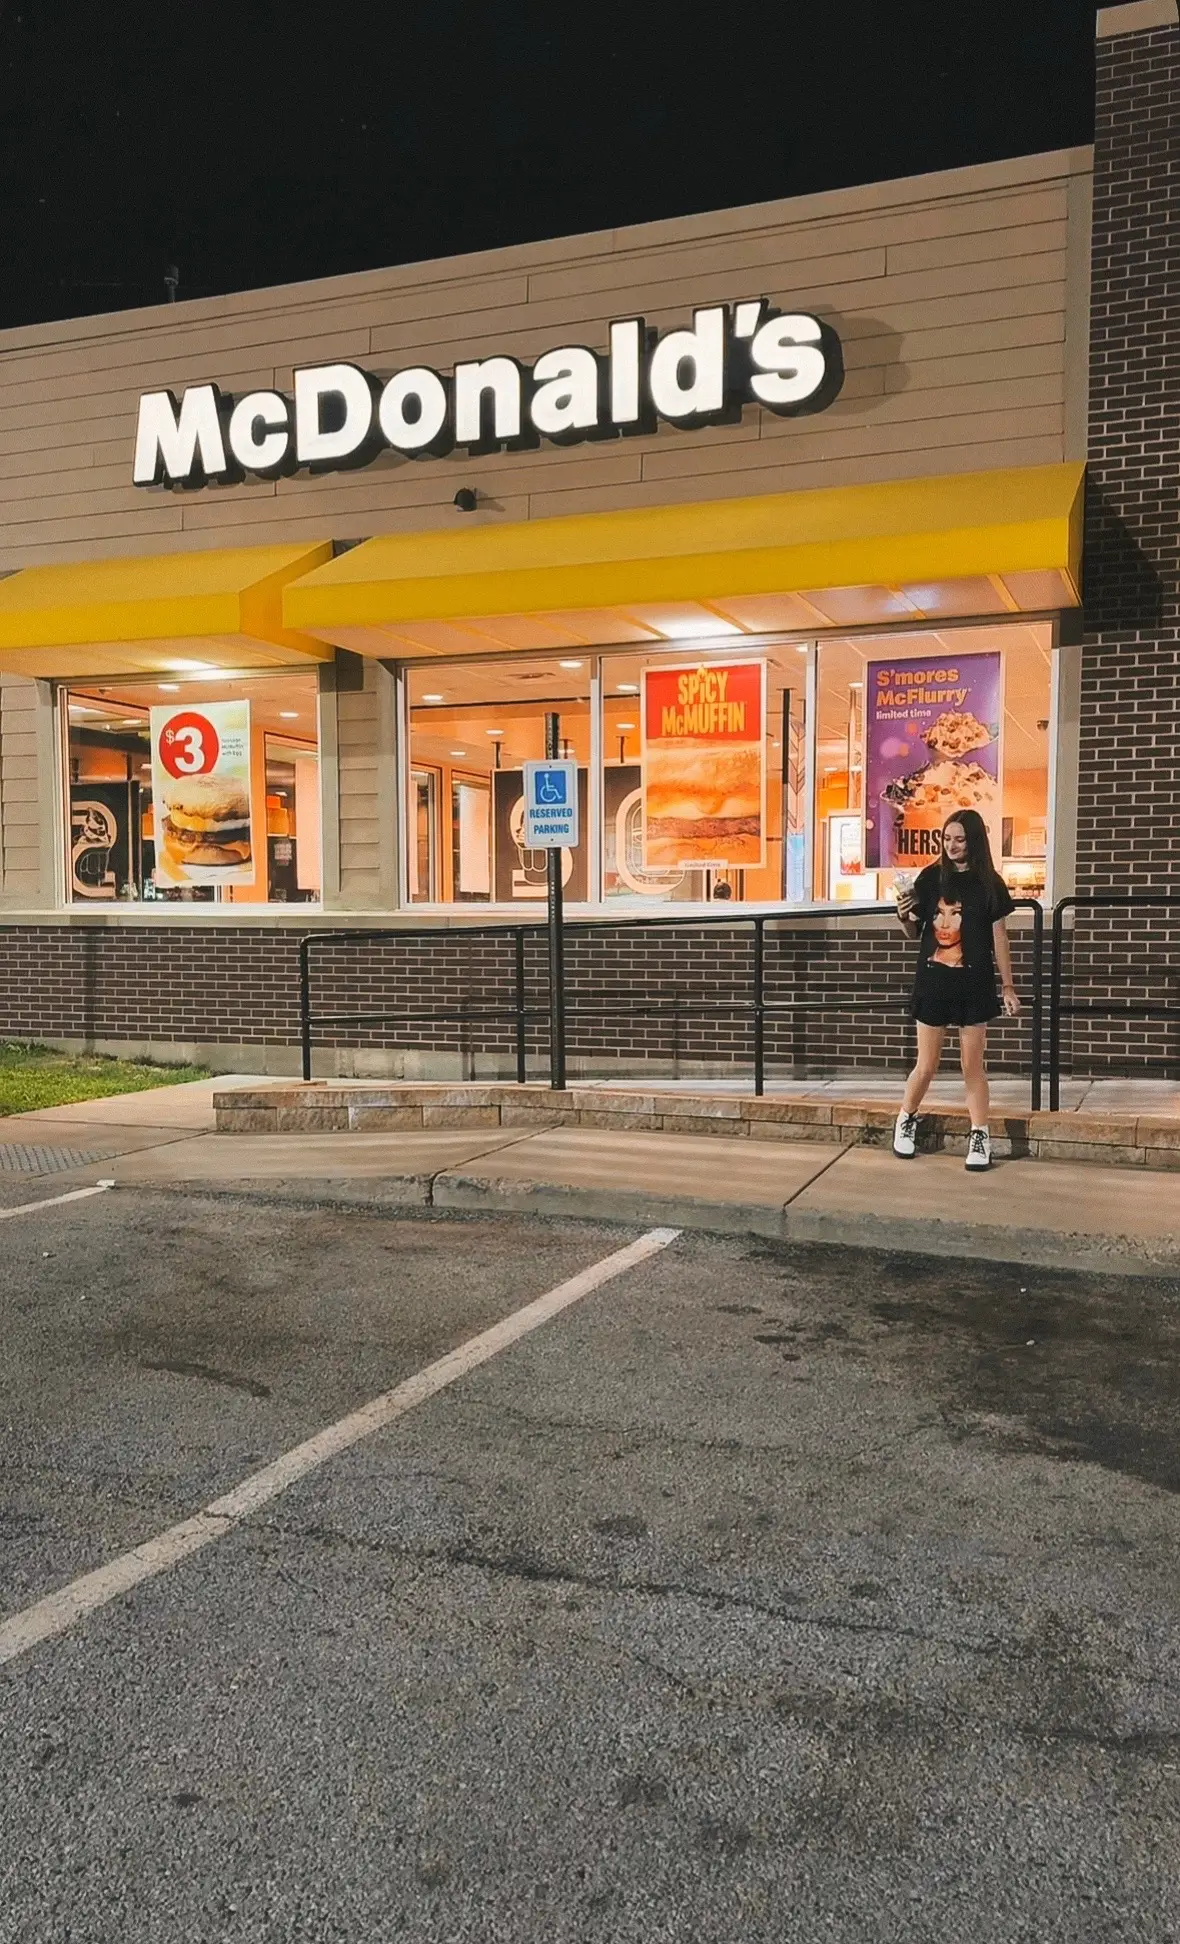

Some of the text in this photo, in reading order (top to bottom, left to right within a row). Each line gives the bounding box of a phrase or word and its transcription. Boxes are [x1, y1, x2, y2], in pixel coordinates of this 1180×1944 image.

[132, 301, 828, 484] McDonald's
[876, 668, 960, 687] S'mores
[876, 687, 968, 707] McFlurry
[661, 701, 746, 737] McMUFFIN
[876, 708, 932, 720] limited time
[165, 726, 206, 773] $3
[529, 807, 573, 819] RESERVED
[533, 823, 570, 835] PARKING
[897, 828, 942, 856] HERS
